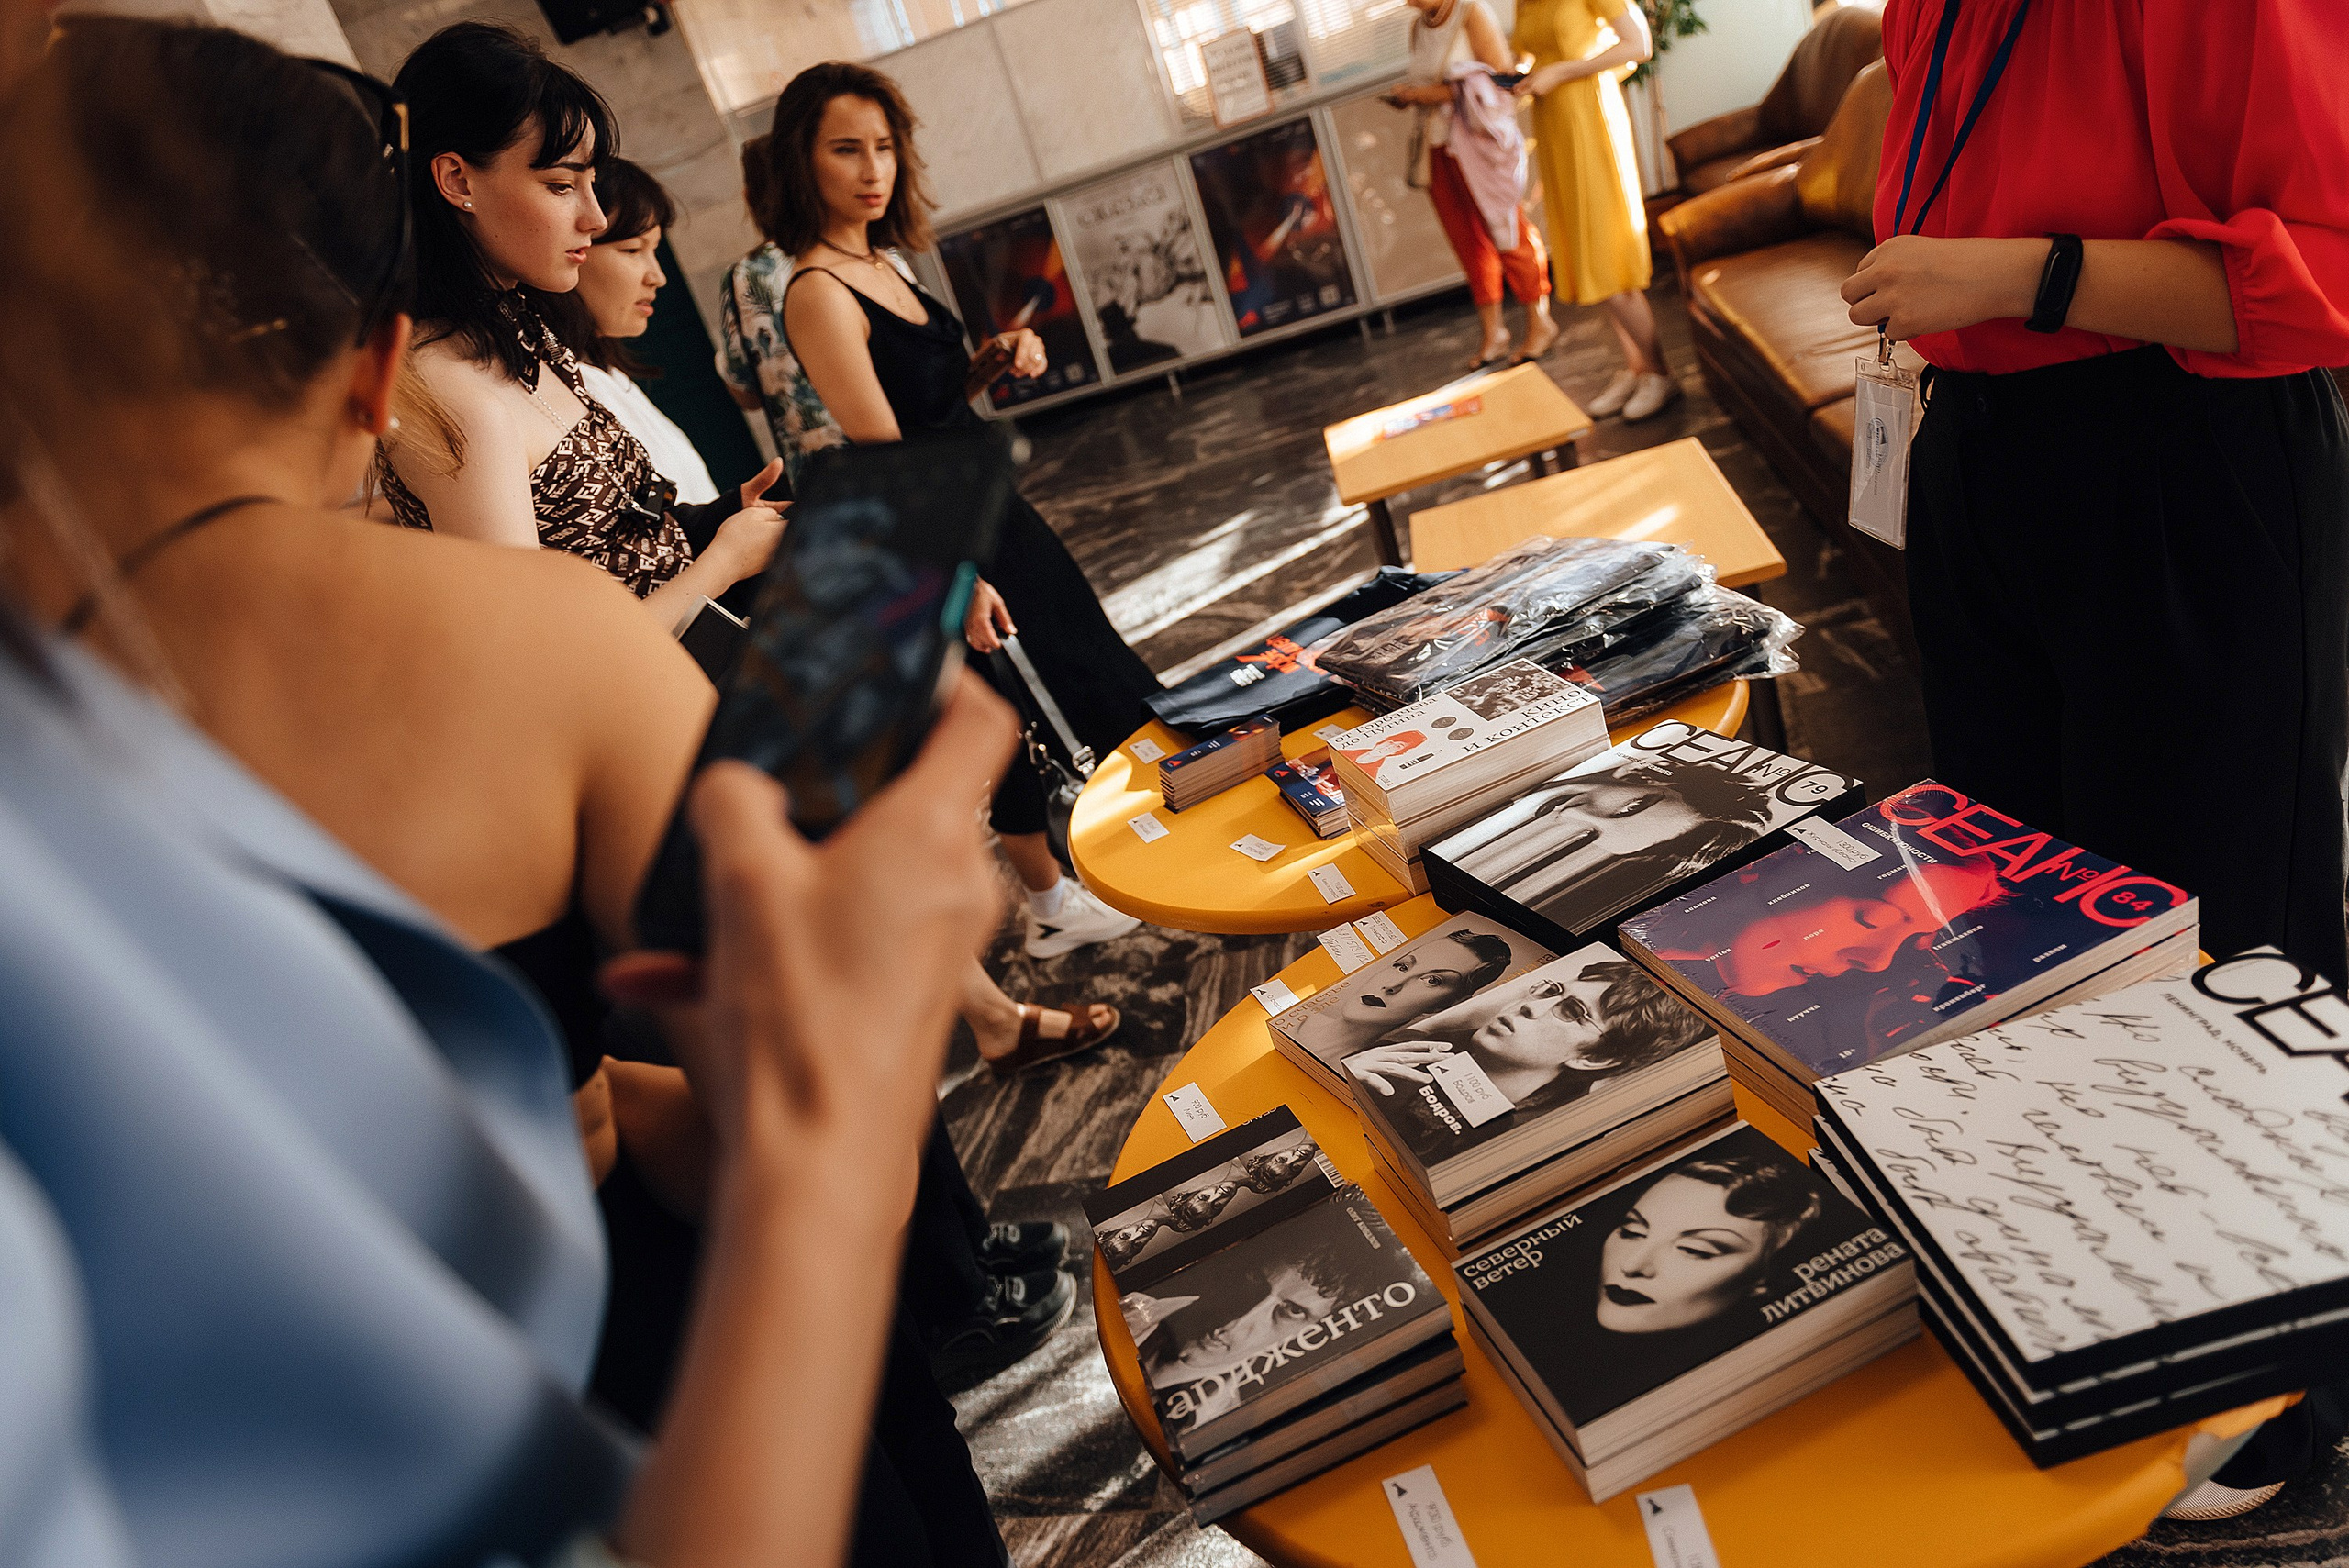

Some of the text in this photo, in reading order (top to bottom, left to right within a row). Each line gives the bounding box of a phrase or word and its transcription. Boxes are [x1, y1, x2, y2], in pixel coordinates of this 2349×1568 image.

[1334, 696, 1439, 743] от Горбачева
[1341, 709, 1426, 750] до Путина
[1799, 780, 1829, 795] 79
[1861, 821, 1900, 846] ОШИБКИ
[1767, 882, 1811, 906] хлебников
[2110, 891, 2154, 912] 84
[1932, 924, 1985, 951] traumazone
[1704, 947, 1732, 962] vortex
[1288, 982, 1351, 1018] счастье
[1297, 1014, 1308, 1022] о
[1311, 996, 1341, 1014] зле
[1932, 983, 1987, 1012] кроненберг
[2191, 952, 2349, 1092] СЕ
[1453, 1079, 1475, 1104] Бодров
[1464, 1072, 1481, 1092] 1100
[1418, 1084, 1463, 1136] Бодров.
[1464, 1213, 1584, 1277] северный
[1792, 1227, 1890, 1286] рената
[1472, 1250, 1544, 1291] ветер
[1759, 1241, 1908, 1323] литвинова
[1165, 1281, 1416, 1421] ардженто
